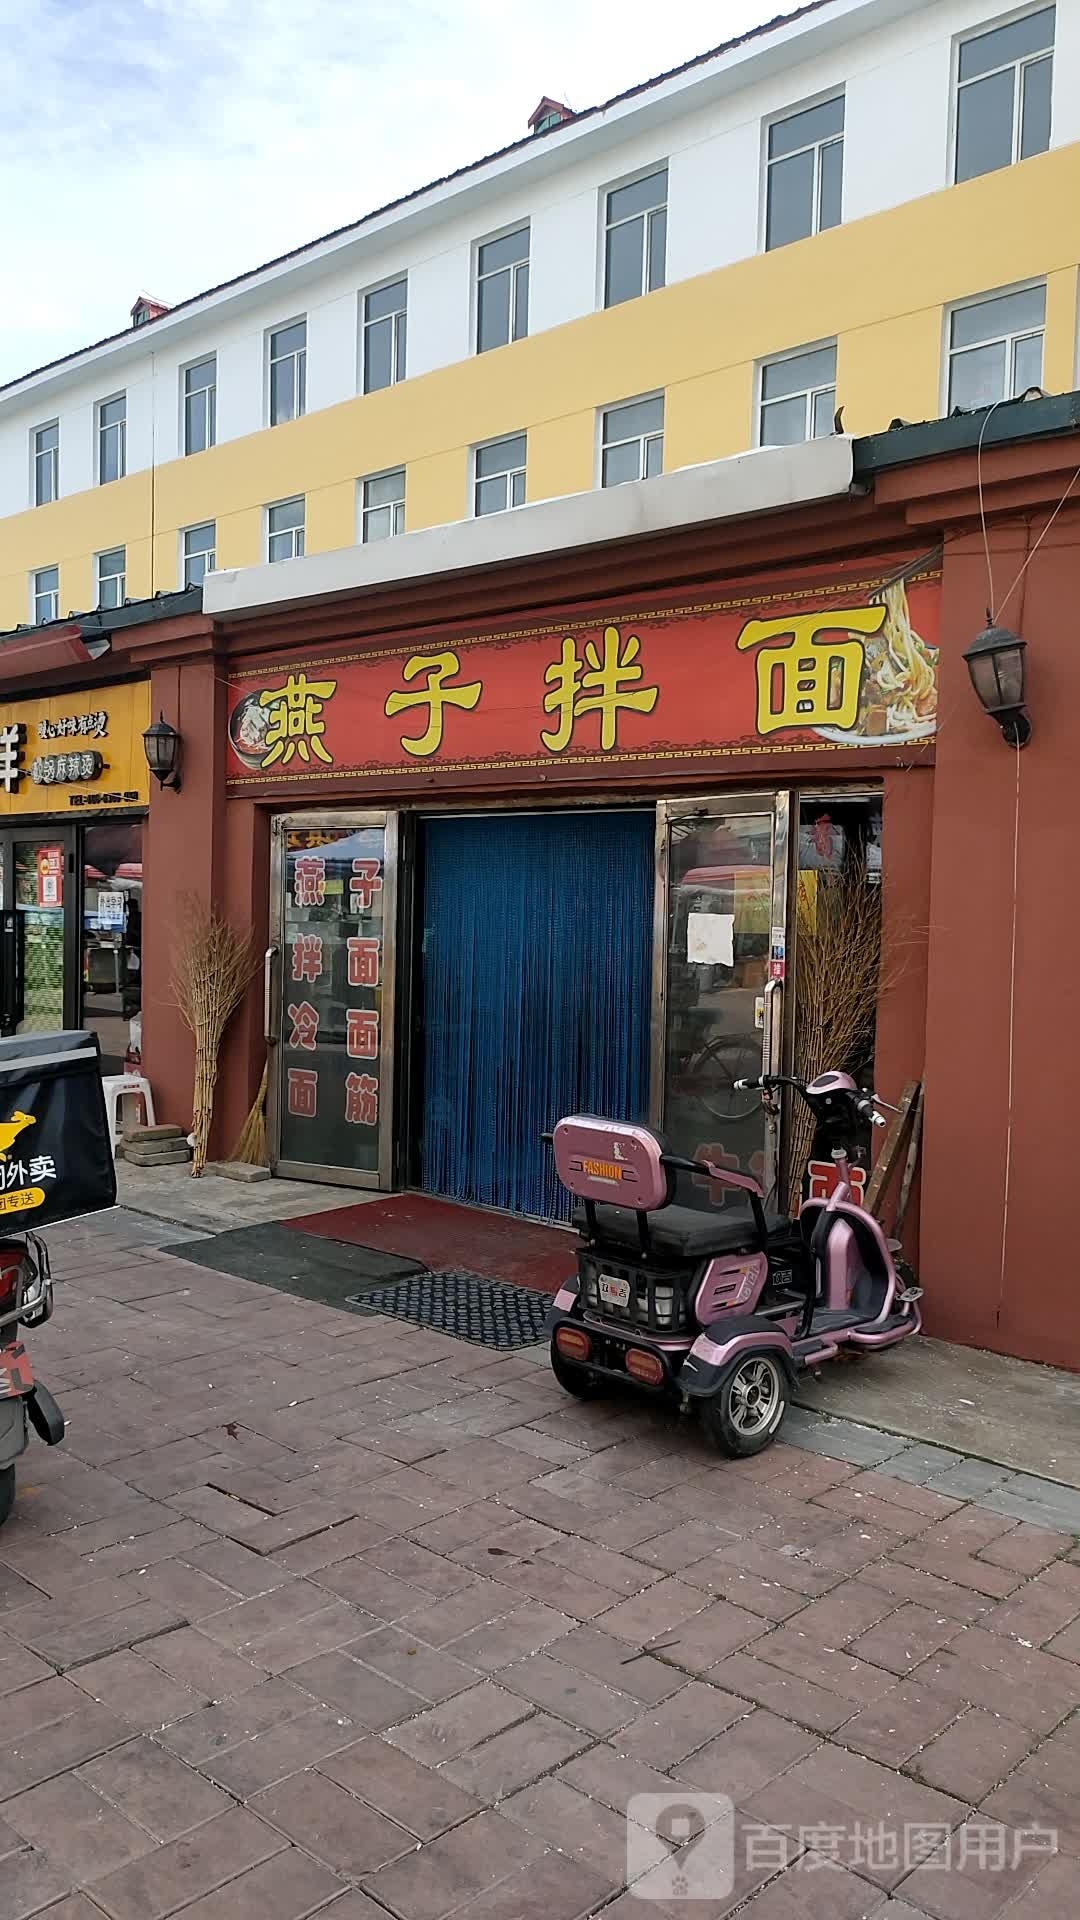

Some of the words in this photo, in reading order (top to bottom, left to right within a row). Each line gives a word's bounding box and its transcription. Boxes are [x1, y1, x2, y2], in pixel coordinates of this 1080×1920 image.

[259, 603, 888, 769] 燕子拌面
[0, 1155, 57, 1190] 外卖
[583, 1160, 622, 1180] FASHION
